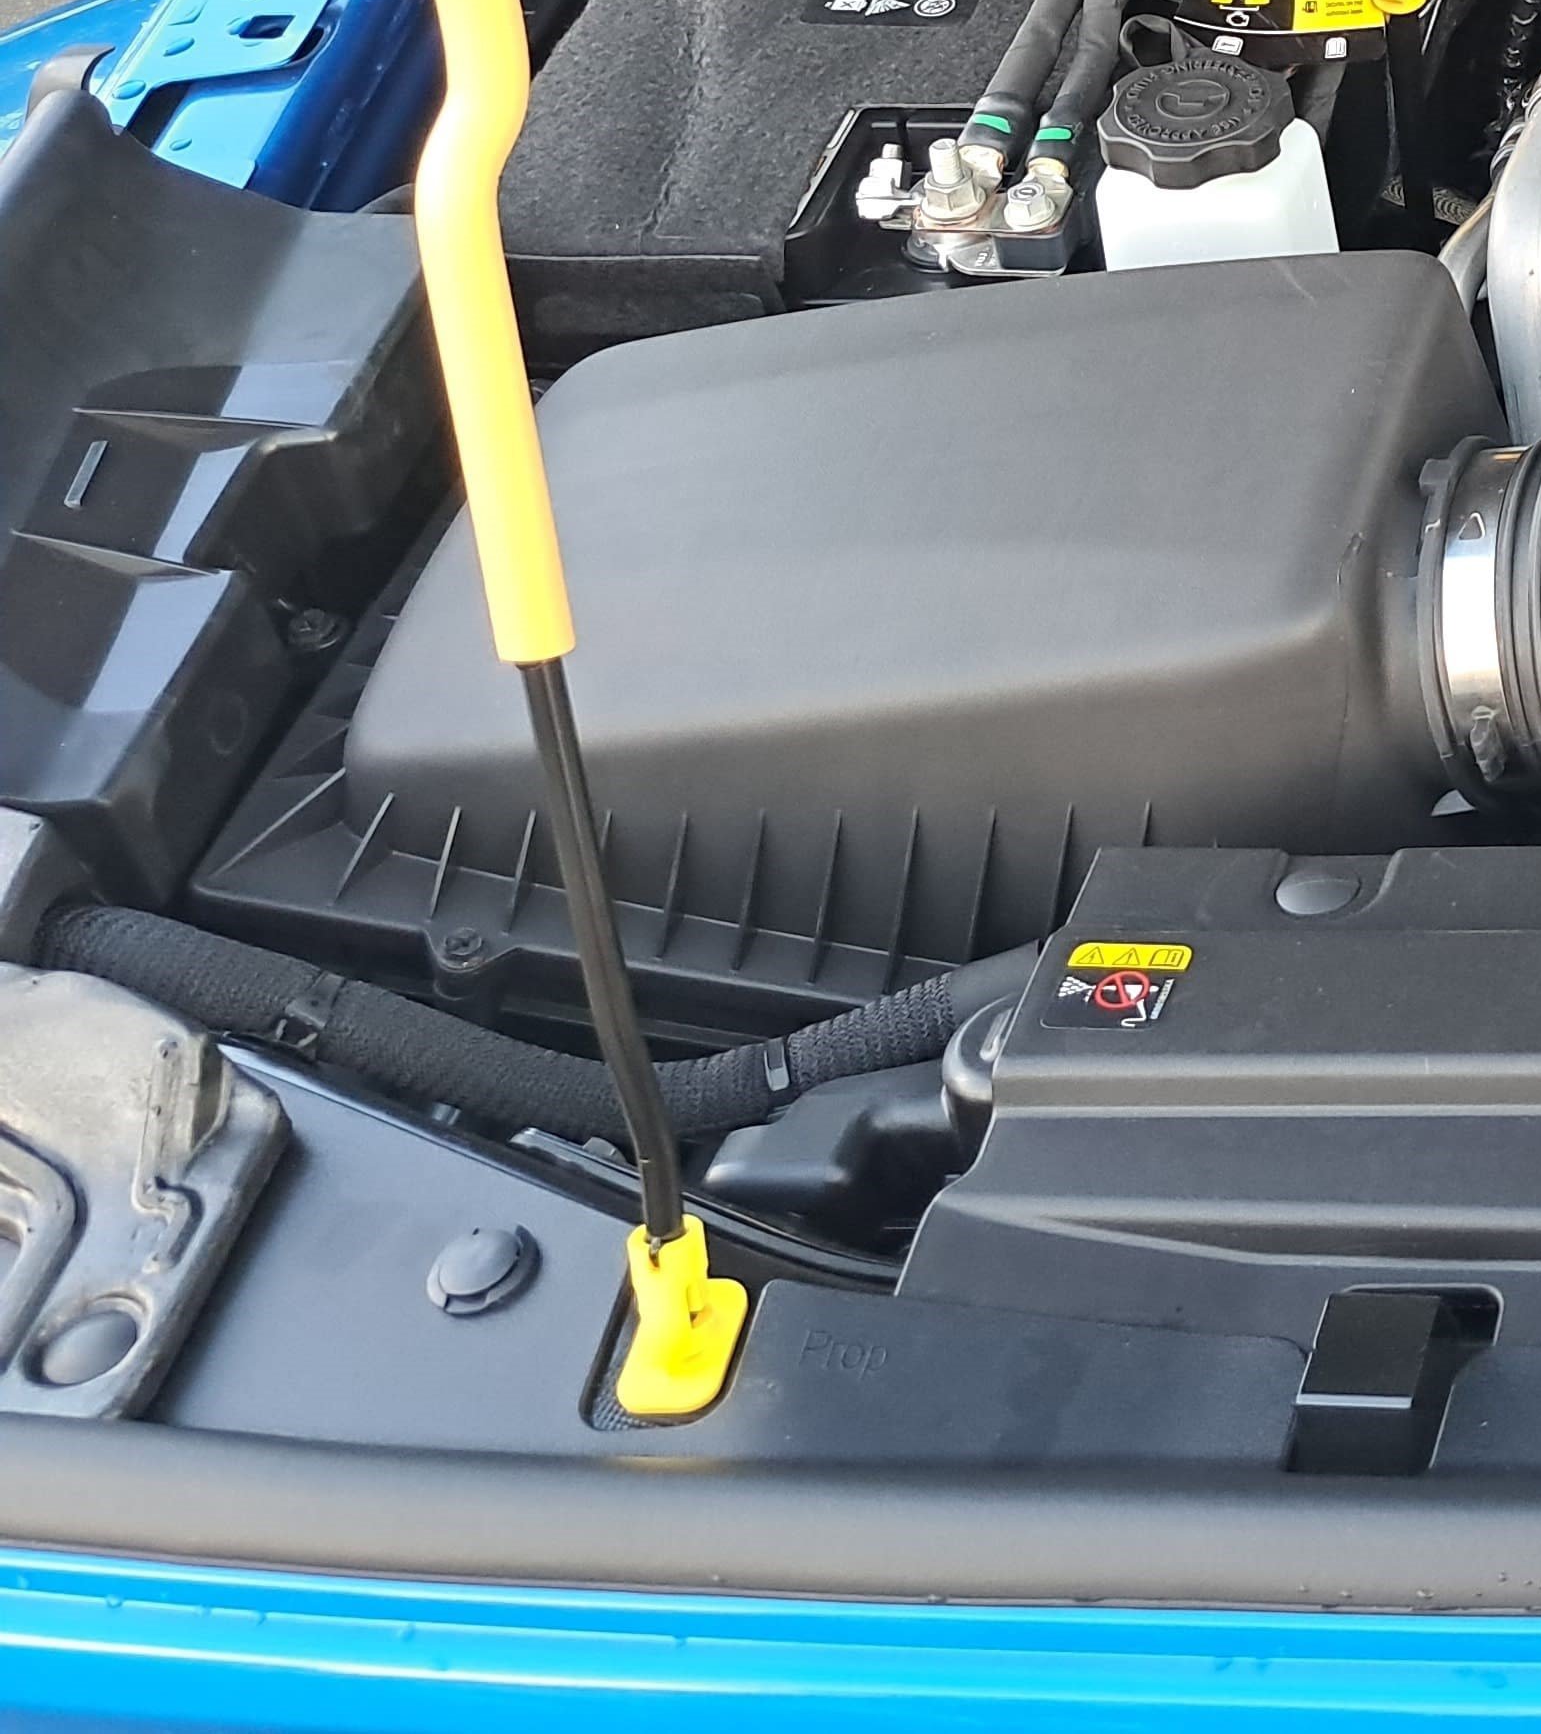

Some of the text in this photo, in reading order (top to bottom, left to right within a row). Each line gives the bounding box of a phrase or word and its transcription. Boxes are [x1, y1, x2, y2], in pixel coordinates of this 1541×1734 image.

[1127, 113, 1241, 141] USE APPROVED
[799, 1329, 889, 1379] Prop
